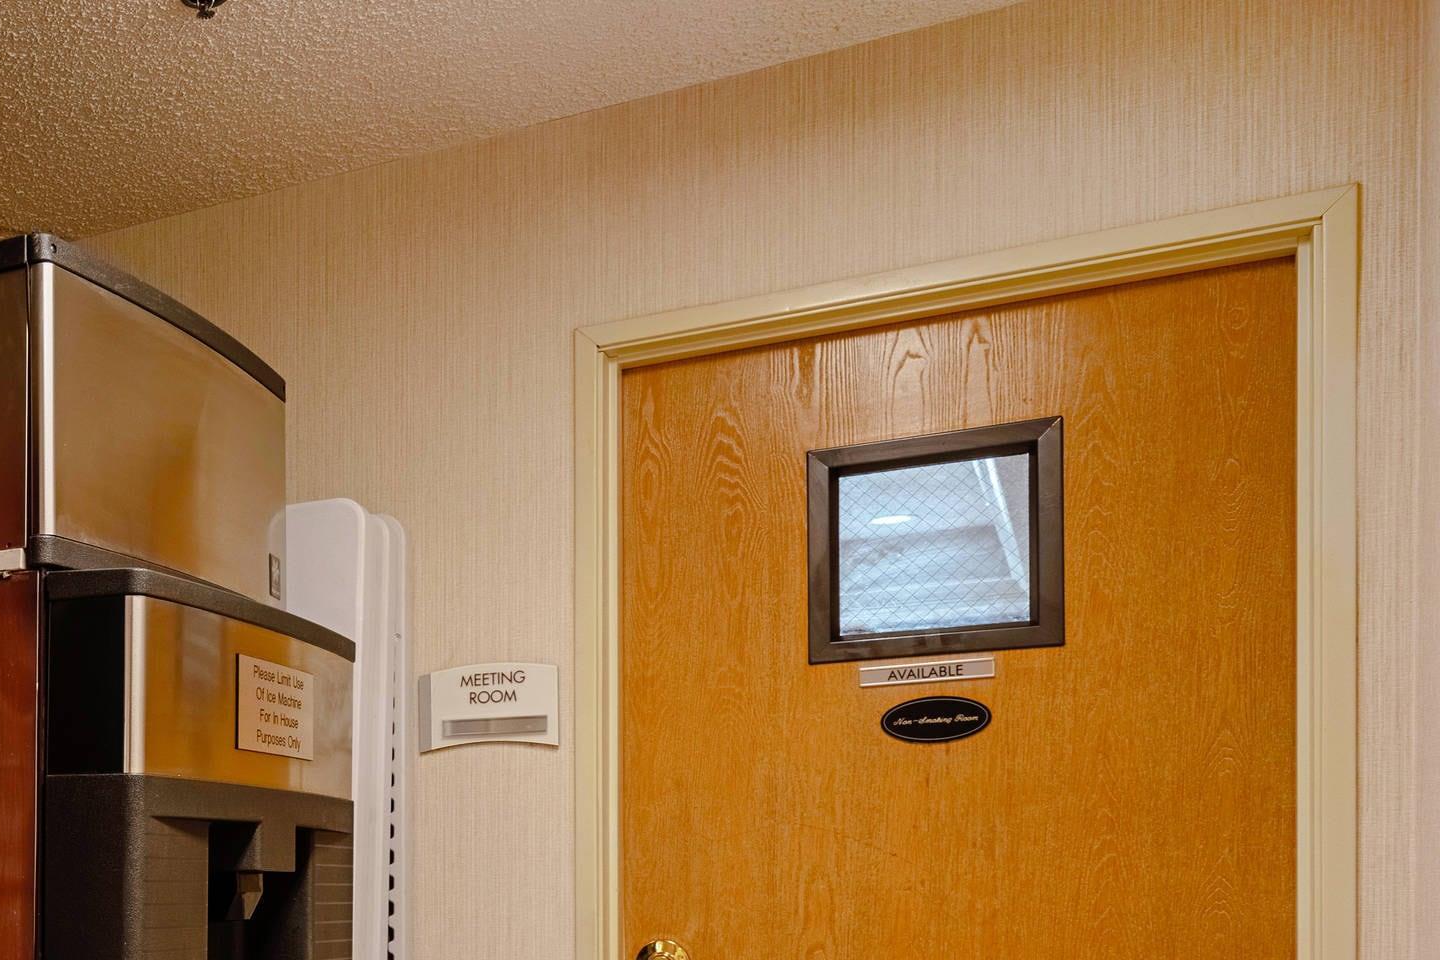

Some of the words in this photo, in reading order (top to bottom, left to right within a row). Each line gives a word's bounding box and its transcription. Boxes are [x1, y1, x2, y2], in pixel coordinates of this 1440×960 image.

[253, 664, 275, 682] Please
[276, 671, 291, 686] Limit
[292, 675, 304, 691] Use
[460, 669, 526, 688] MEETING
[887, 664, 964, 681] AVAILABLE
[255, 686, 265, 701] Of
[266, 688, 276, 703] Ice
[277, 691, 302, 709] Machine
[469, 689, 518, 705] ROOM
[259, 708, 271, 723] For
[280, 713, 299, 729] House
[954, 713, 979, 723] Room
[256, 729, 286, 748] Purposes
[287, 735, 302, 753] Only
